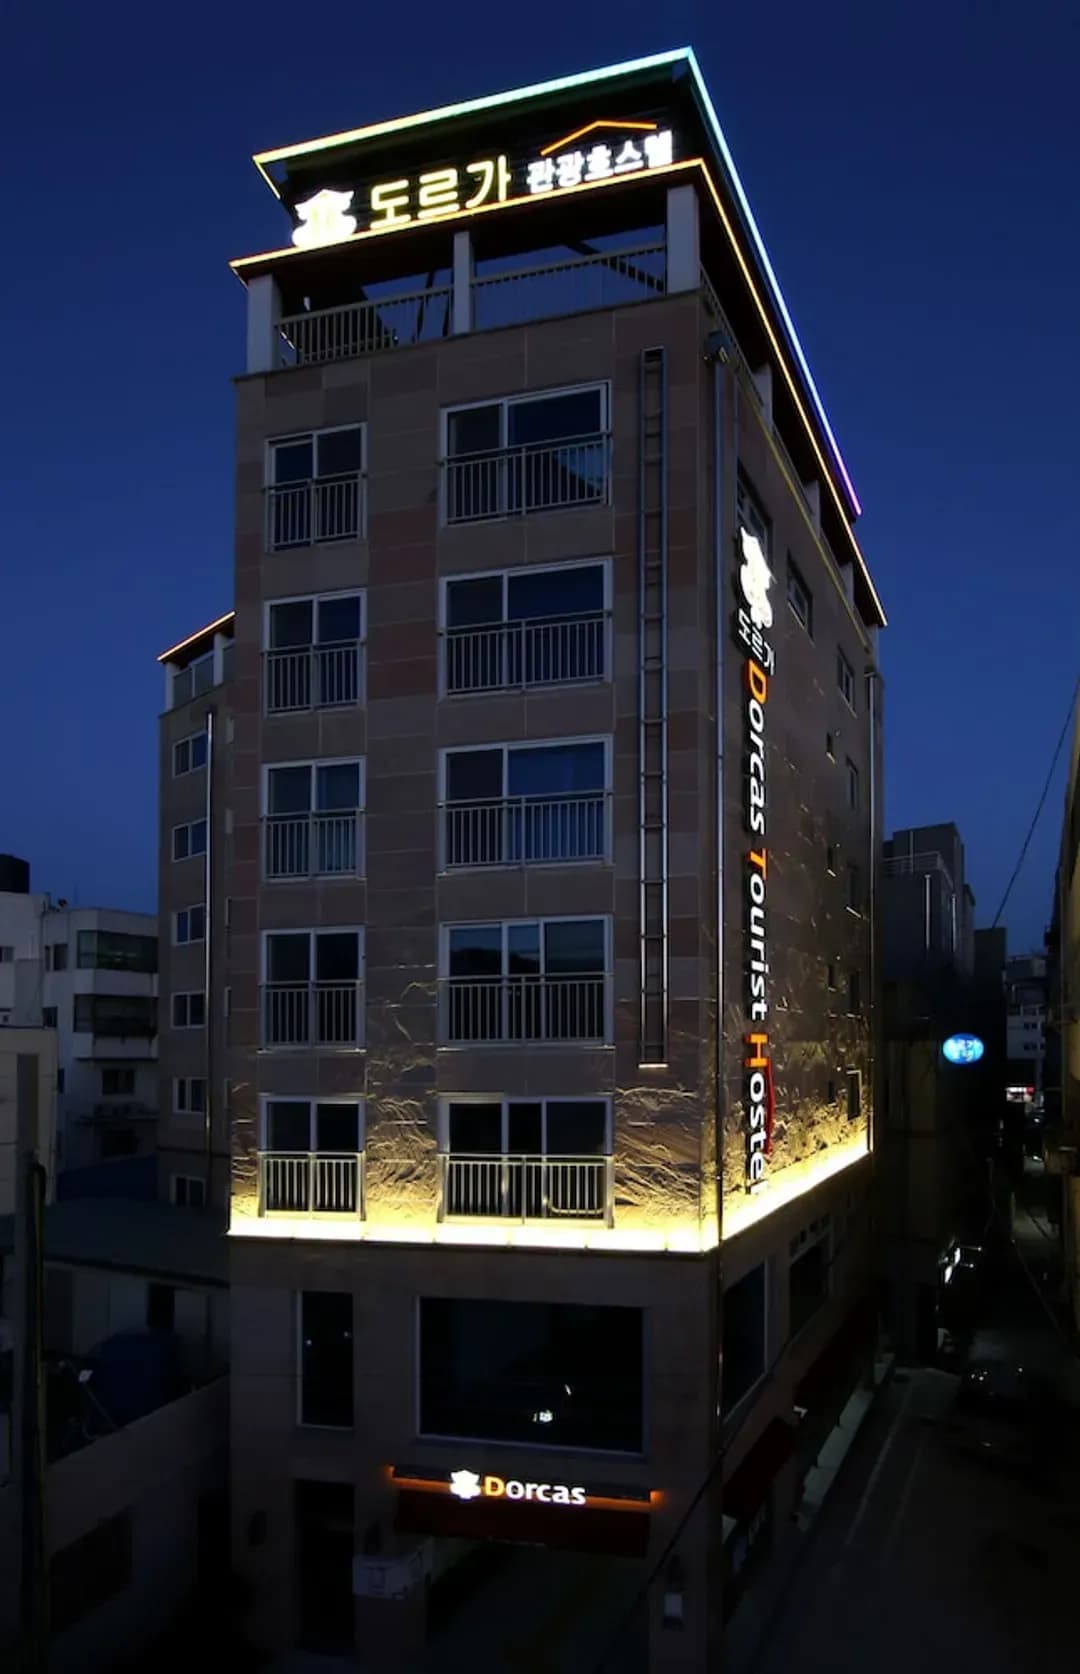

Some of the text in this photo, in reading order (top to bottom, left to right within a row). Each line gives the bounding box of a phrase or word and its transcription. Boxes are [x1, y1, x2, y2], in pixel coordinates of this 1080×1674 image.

[369, 153, 511, 230] 도르가
[746, 659, 769, 1196] Dorcas Tourist Hostel
[483, 1475, 587, 1505] Dorcas
